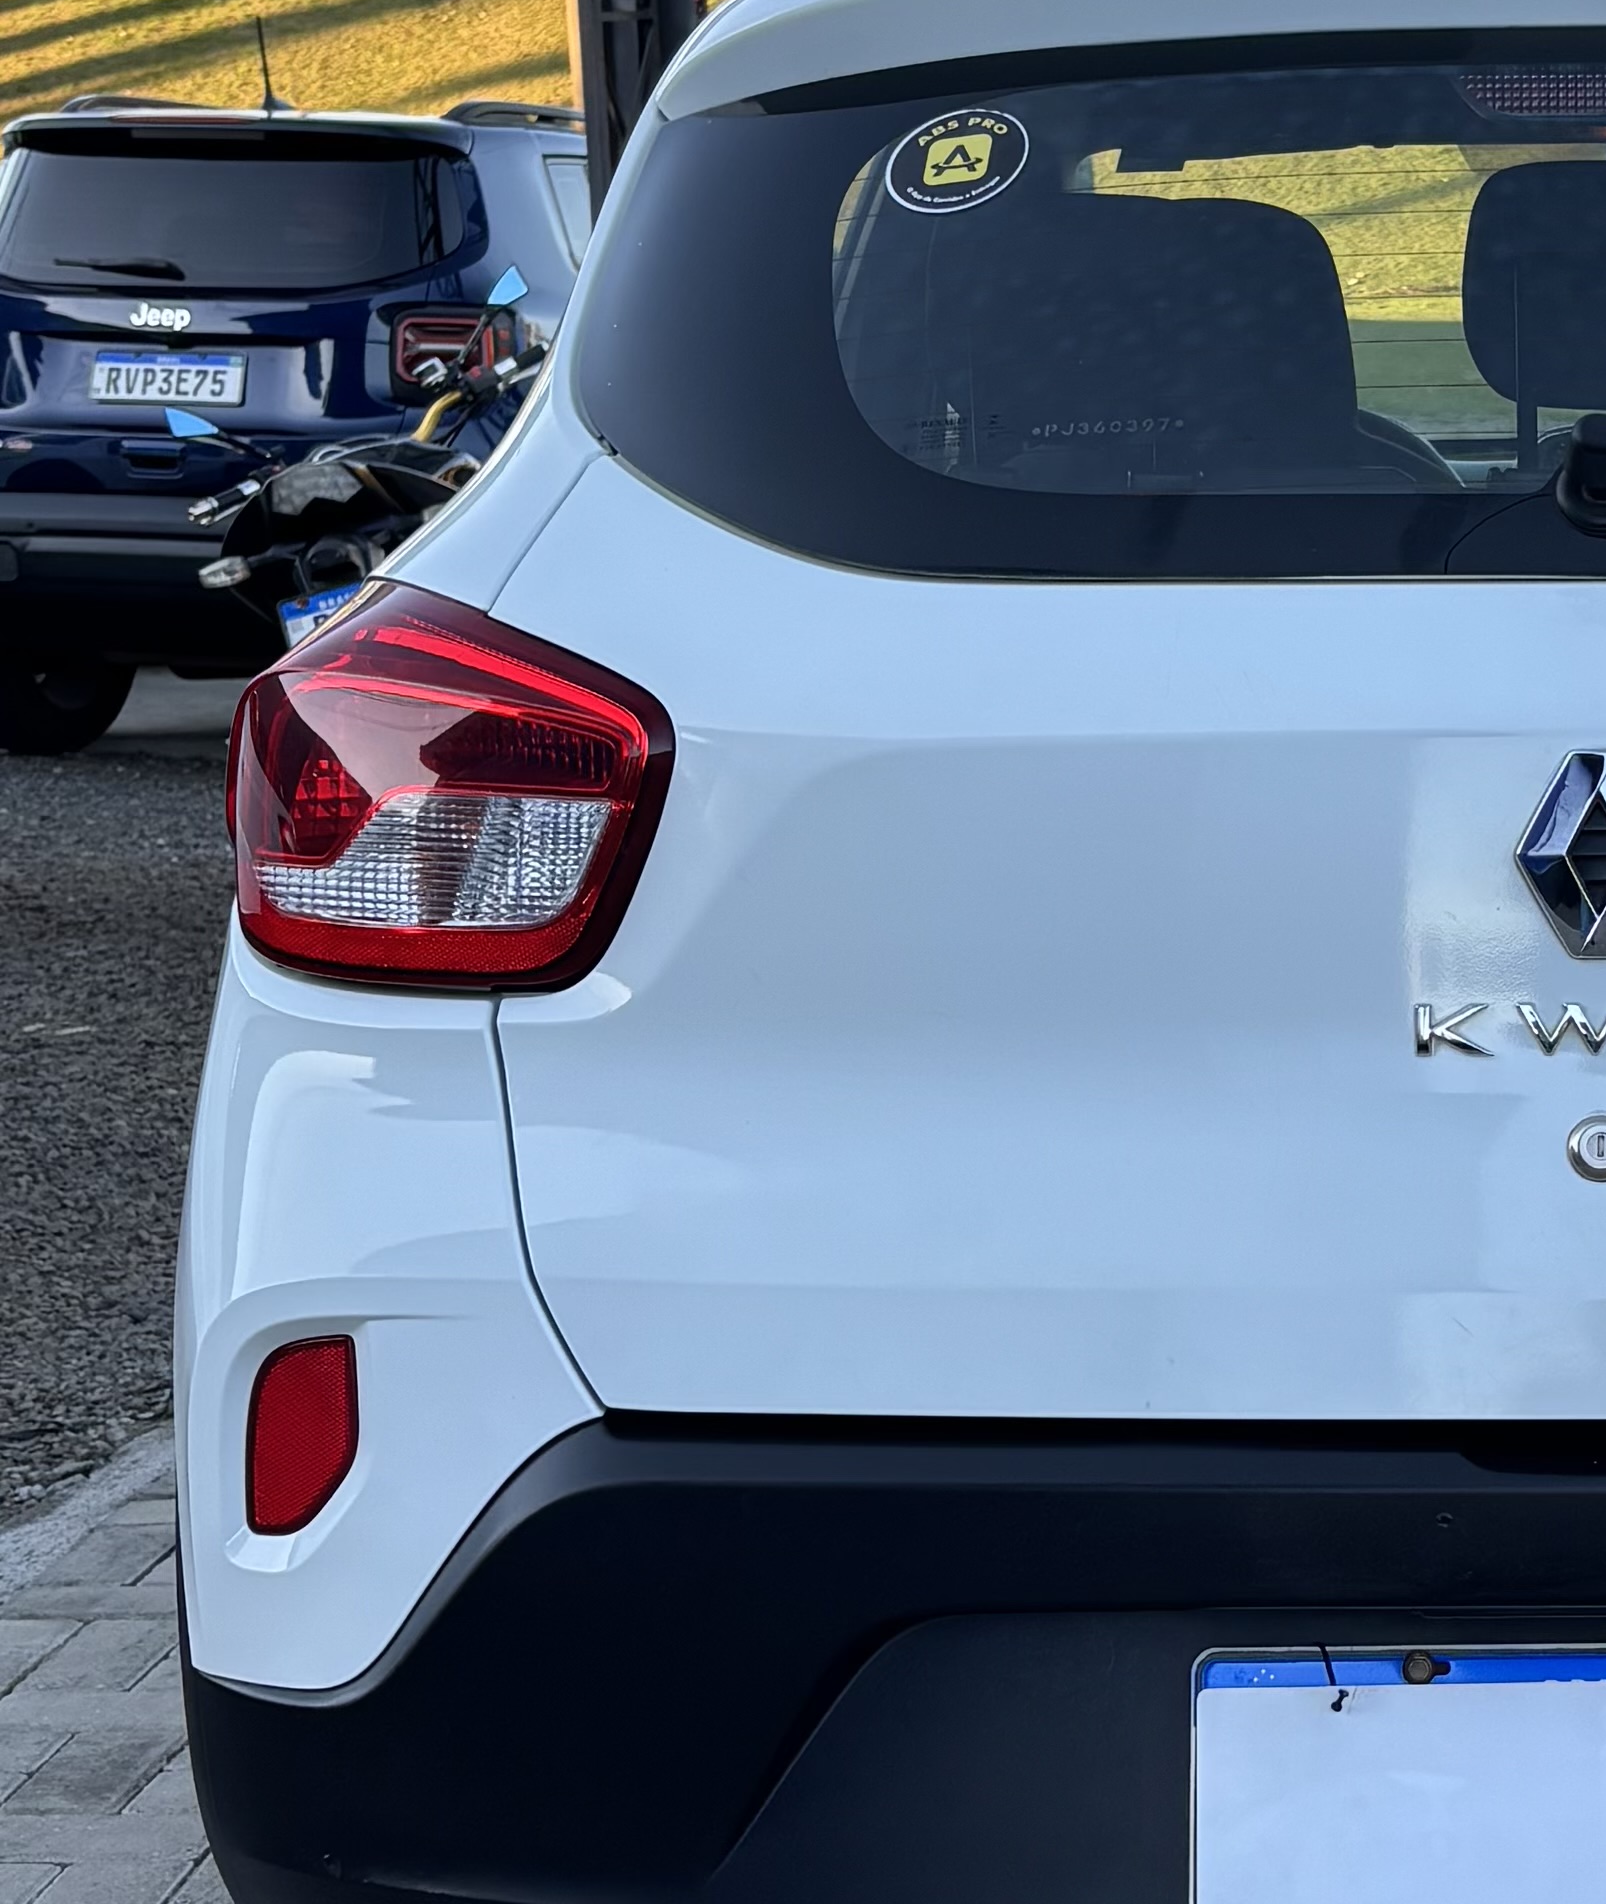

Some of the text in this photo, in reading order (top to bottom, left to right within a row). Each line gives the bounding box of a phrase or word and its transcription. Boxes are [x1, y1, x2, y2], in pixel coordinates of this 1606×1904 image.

[917, 117, 1009, 147] ABS PRO
[128, 301, 192, 332] Jeep
[105, 367, 226, 397] RVP3E75
